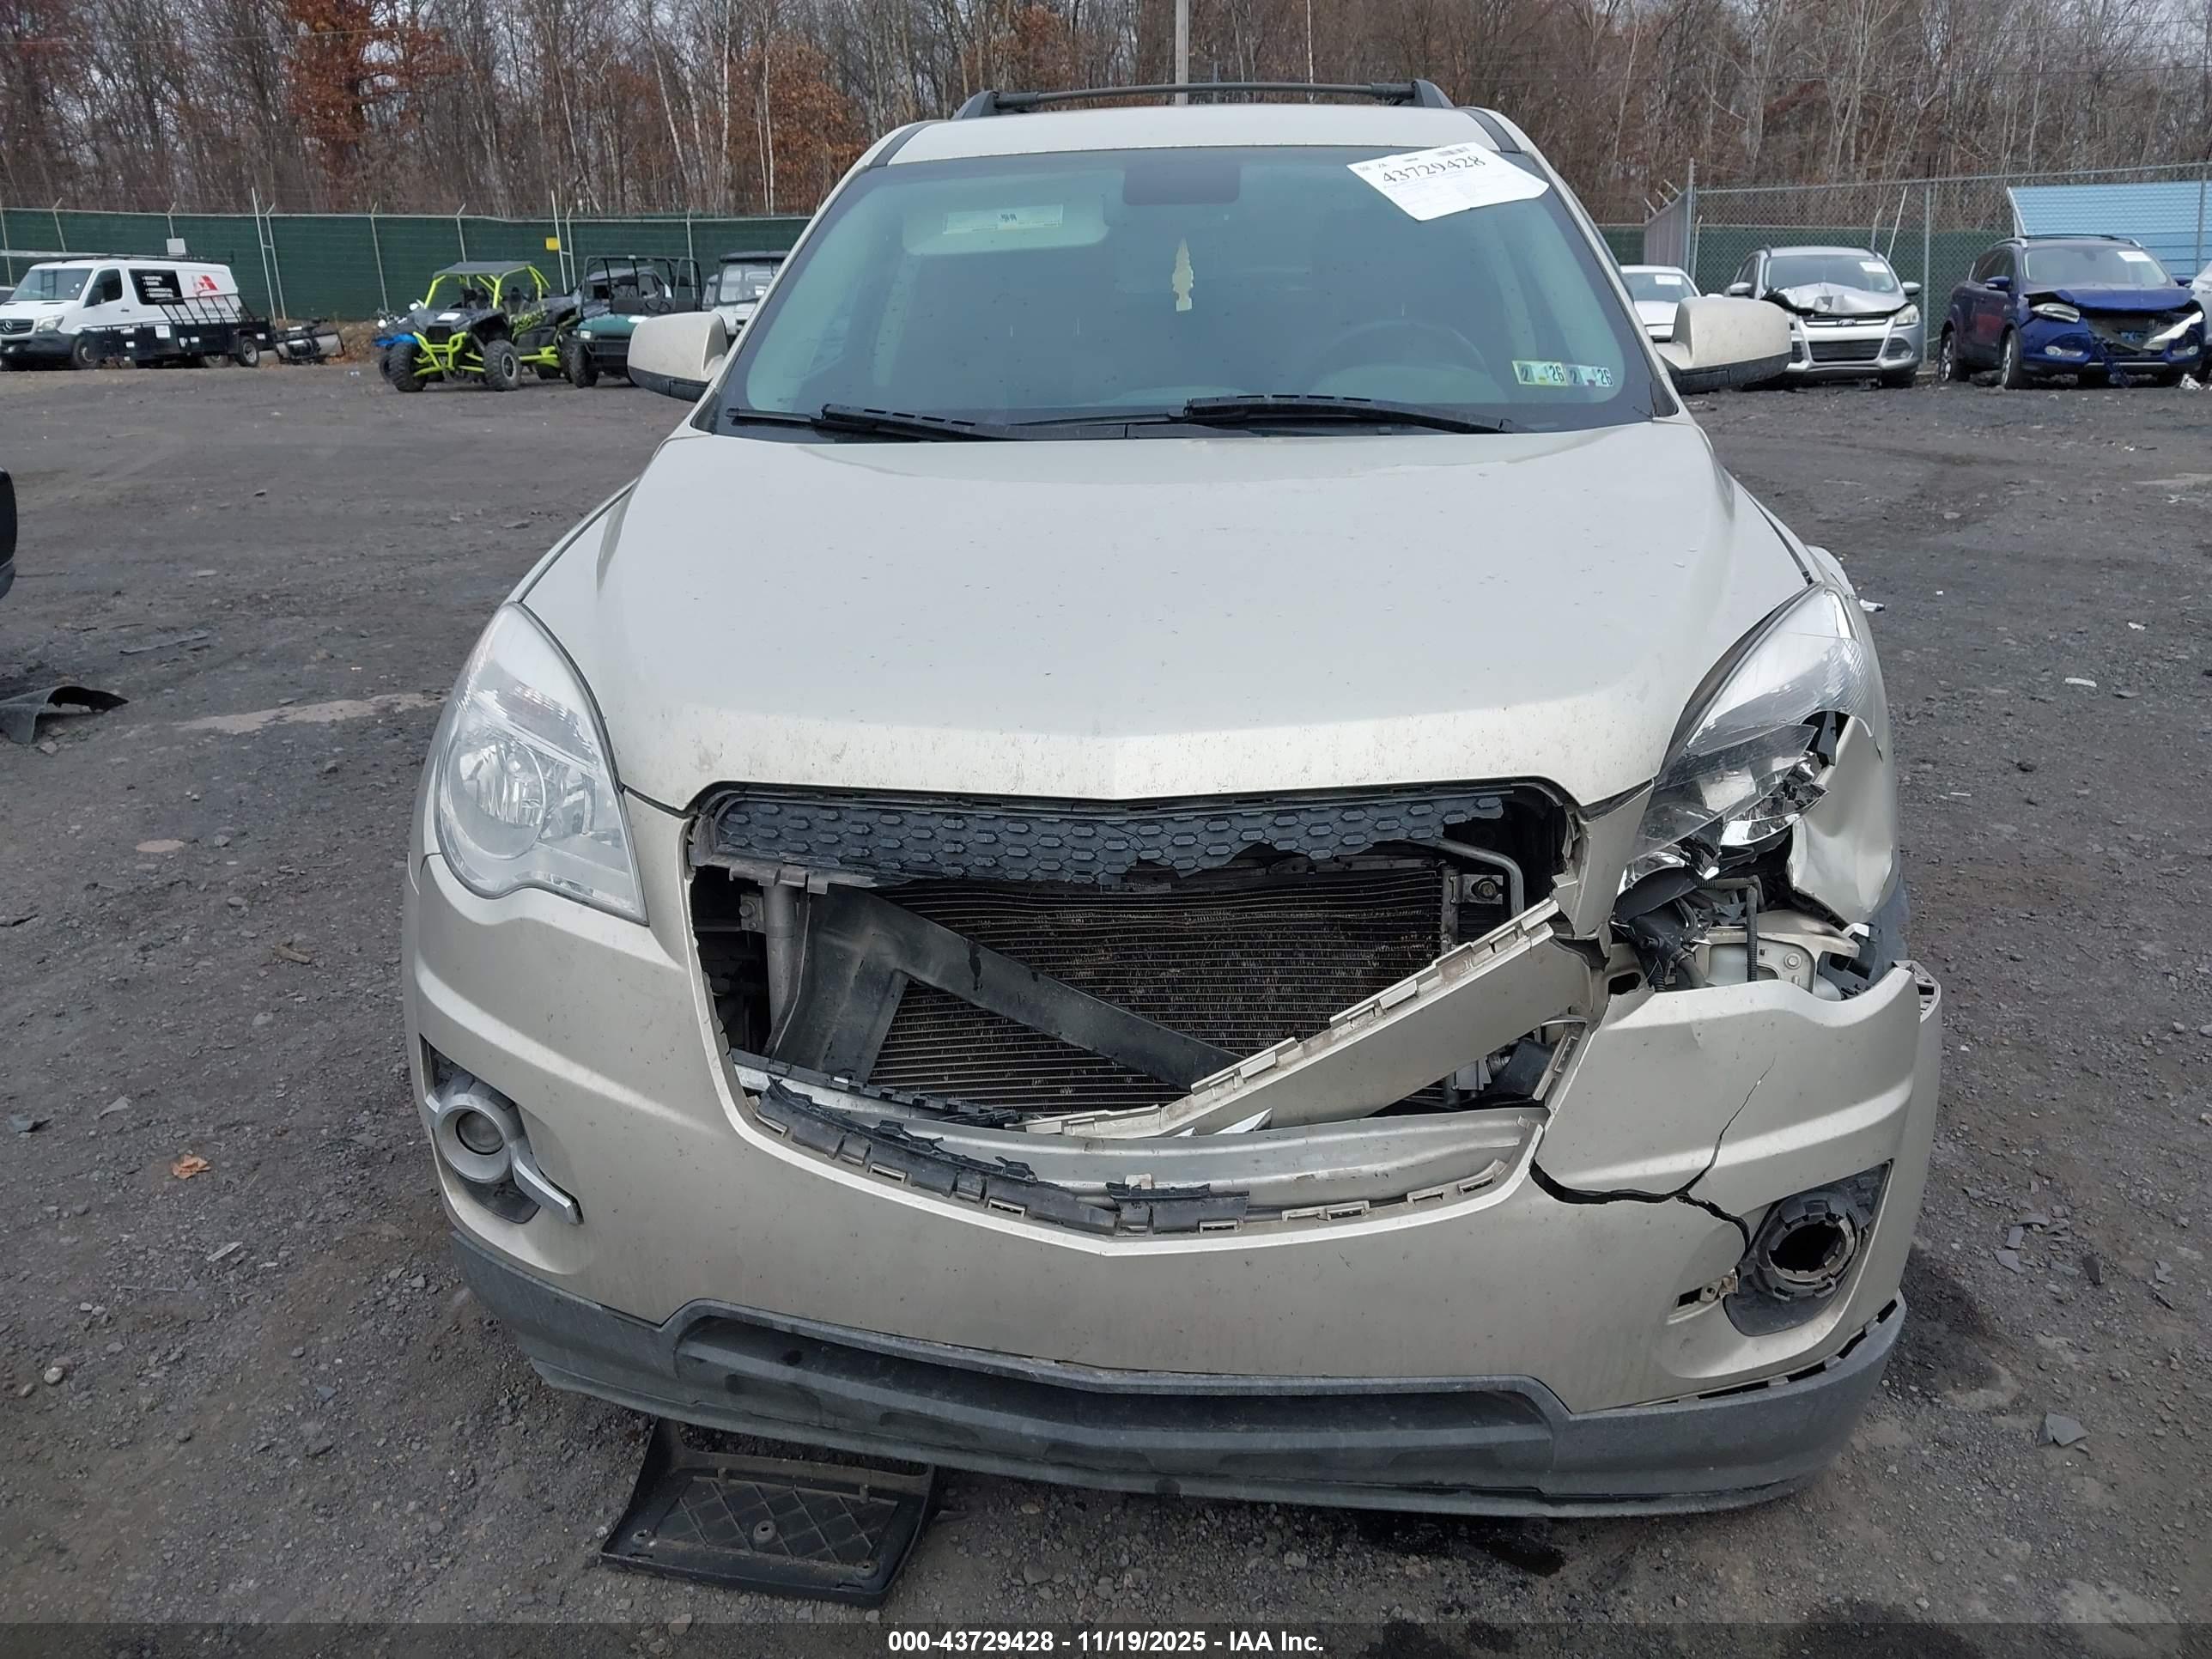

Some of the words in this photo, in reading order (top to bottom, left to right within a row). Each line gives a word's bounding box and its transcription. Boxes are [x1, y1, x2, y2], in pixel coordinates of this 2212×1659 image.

[1382, 155, 1486, 183] 43729428
[1549, 364, 1565, 384] 26
[1597, 368, 1613, 386] 26
